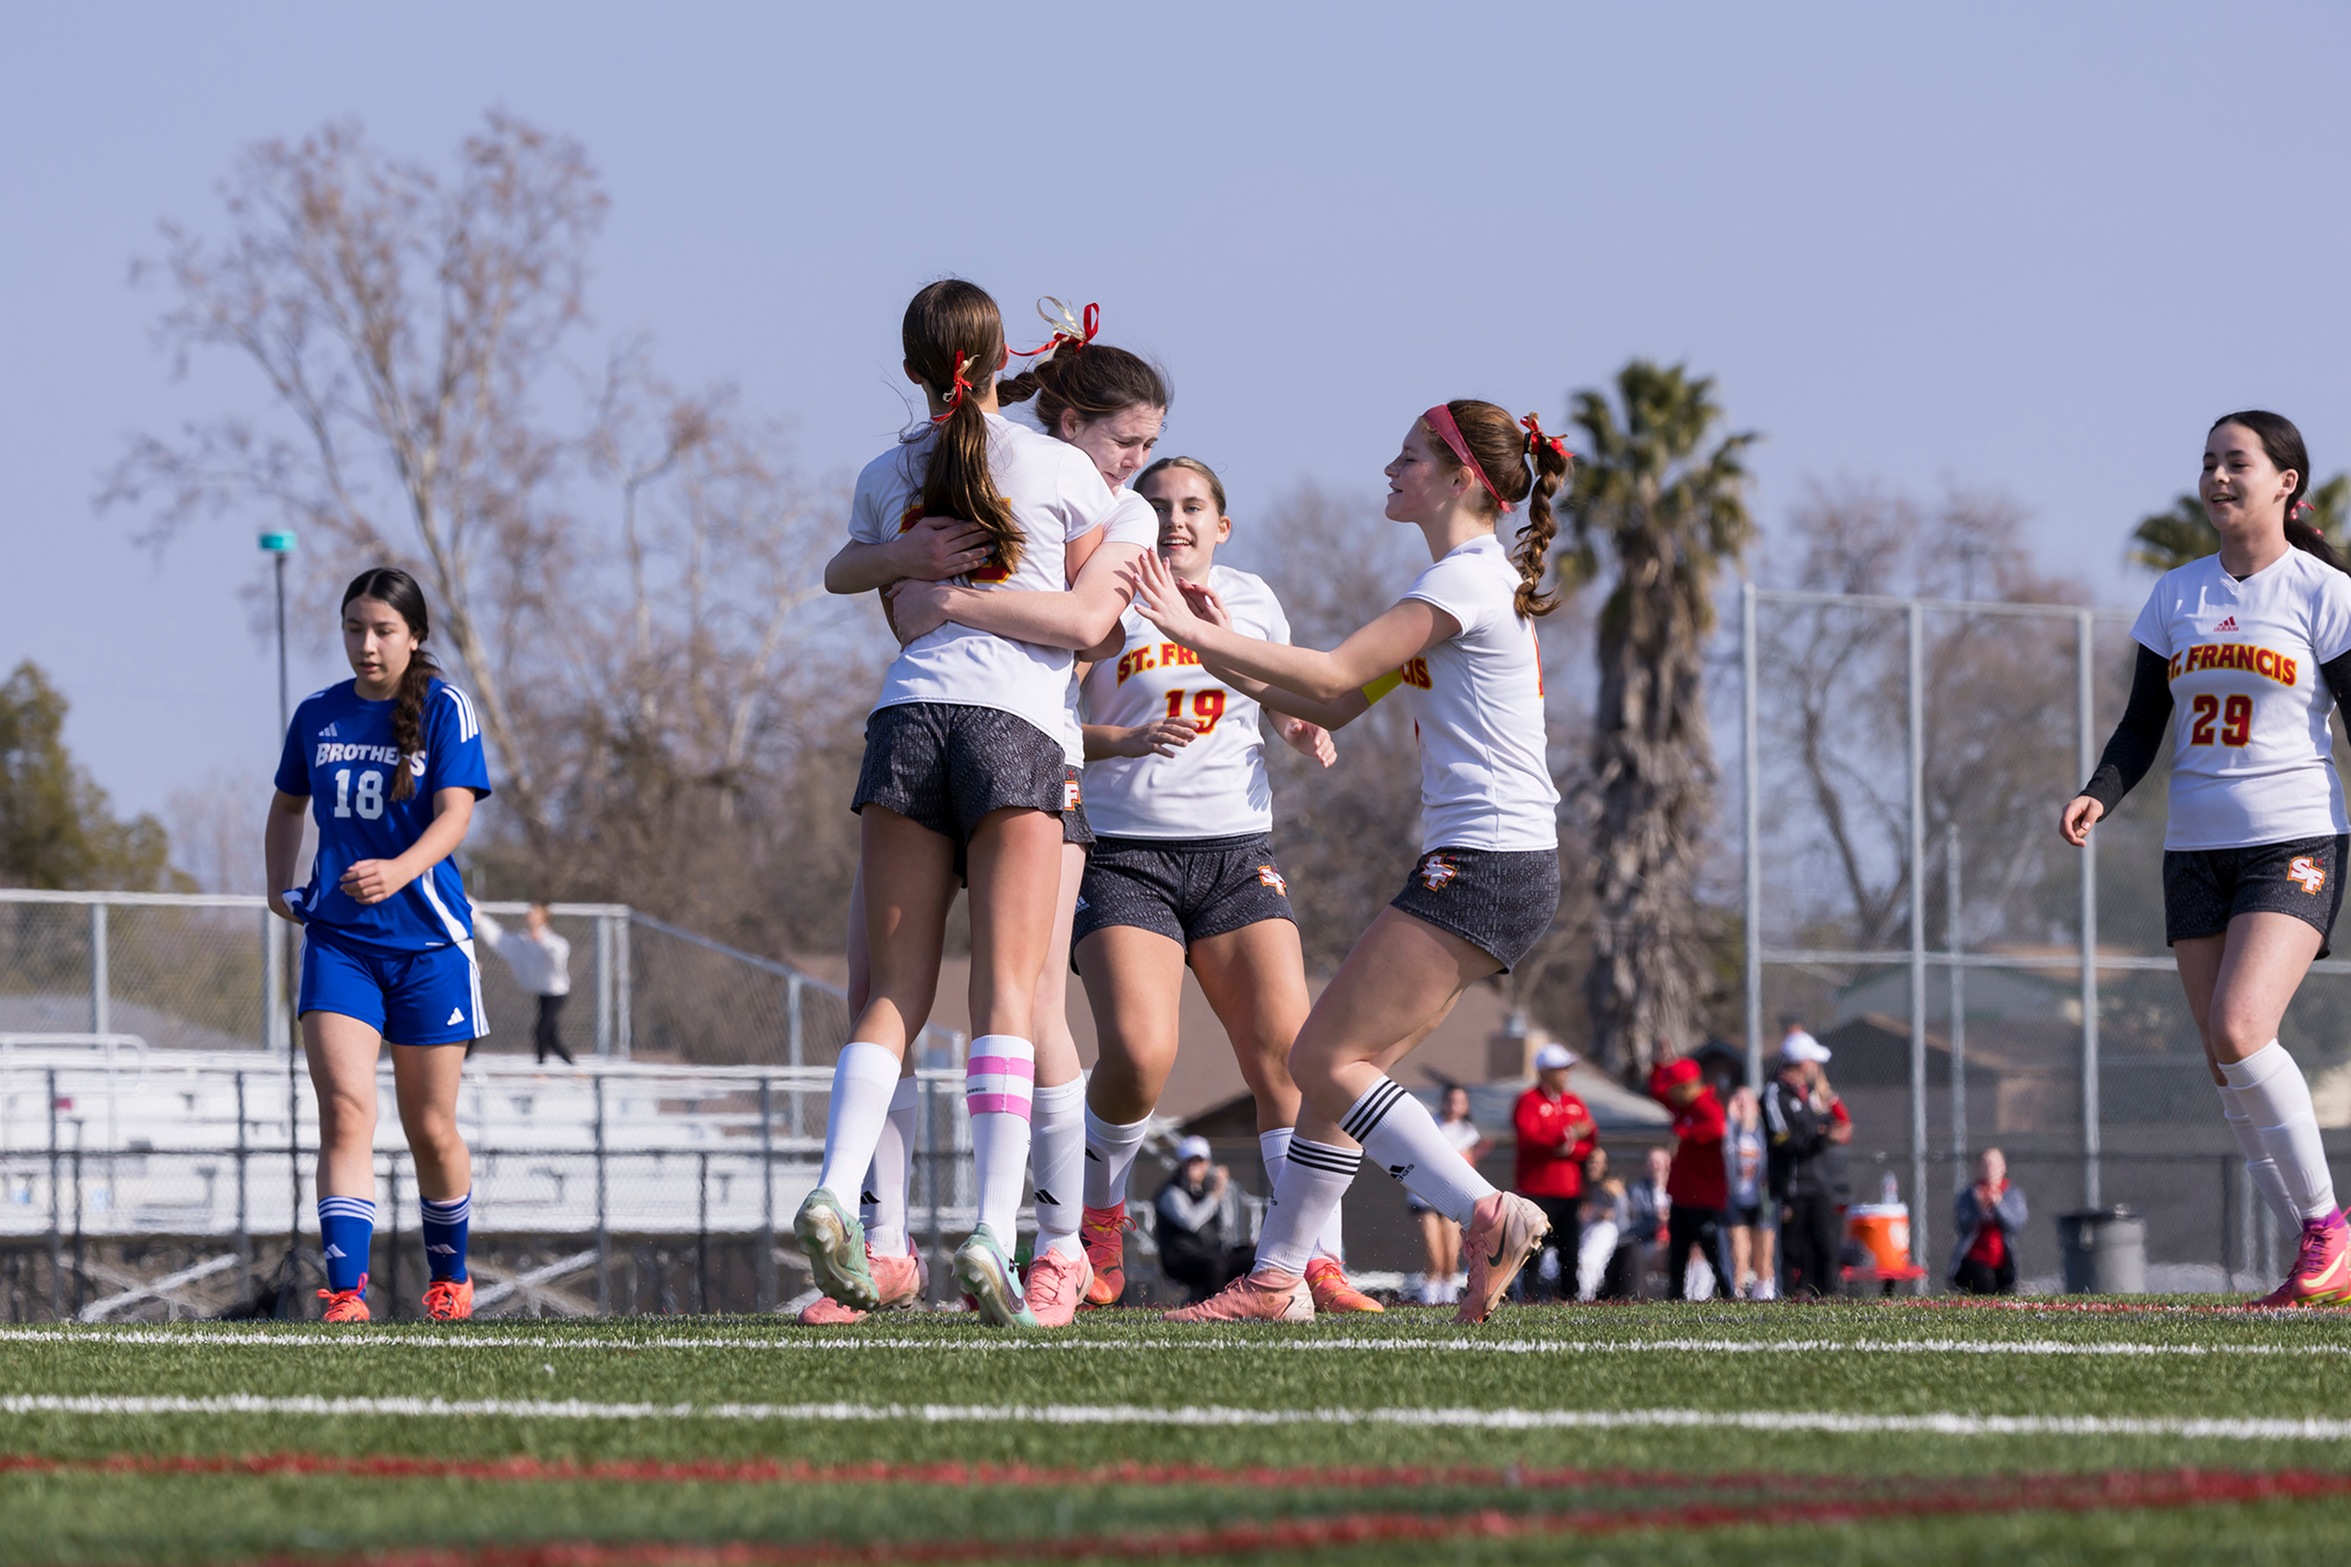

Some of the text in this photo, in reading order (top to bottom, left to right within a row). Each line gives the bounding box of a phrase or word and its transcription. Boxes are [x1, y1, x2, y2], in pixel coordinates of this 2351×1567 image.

[1116, 645, 1156, 688] ST.
[2168, 643, 2297, 687] T. FRANCIS
[1164, 688, 1227, 735] 19
[2190, 693, 2254, 748] 29
[315, 742, 427, 777] BROTHES
[333, 768, 384, 820] 18
[2287, 855, 2326, 896] SF
